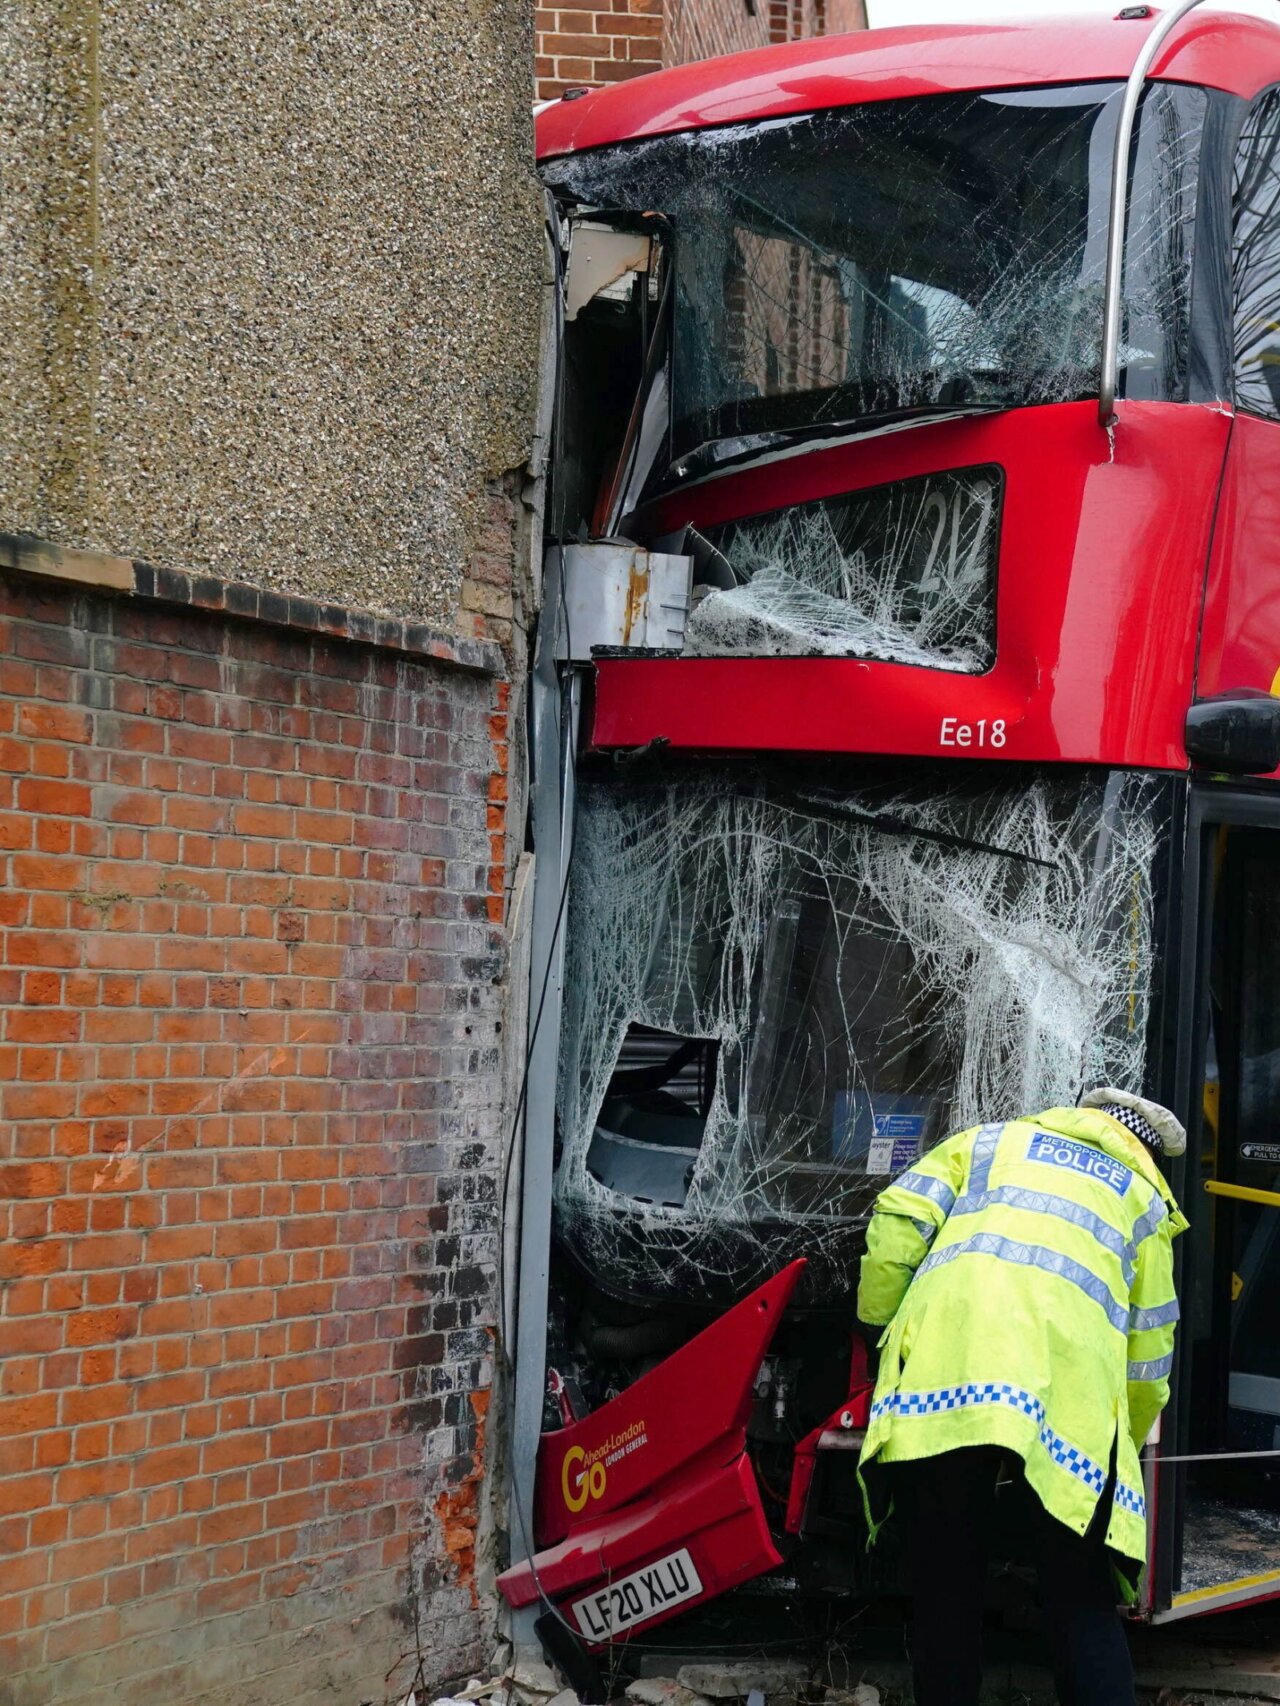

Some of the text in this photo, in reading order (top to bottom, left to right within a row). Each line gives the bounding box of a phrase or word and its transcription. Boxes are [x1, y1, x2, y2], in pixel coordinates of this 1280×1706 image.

[940, 717, 1007, 748] Ee18
[1036, 1144, 1126, 1189] POLICE
[1041, 1136, 1127, 1174] METROPOLITAN
[562, 1419, 645, 1512] Go Ahead-London
[605, 1433, 648, 1467] LONDON GENERAL
[581, 1558, 690, 1636] LF20 XLU
